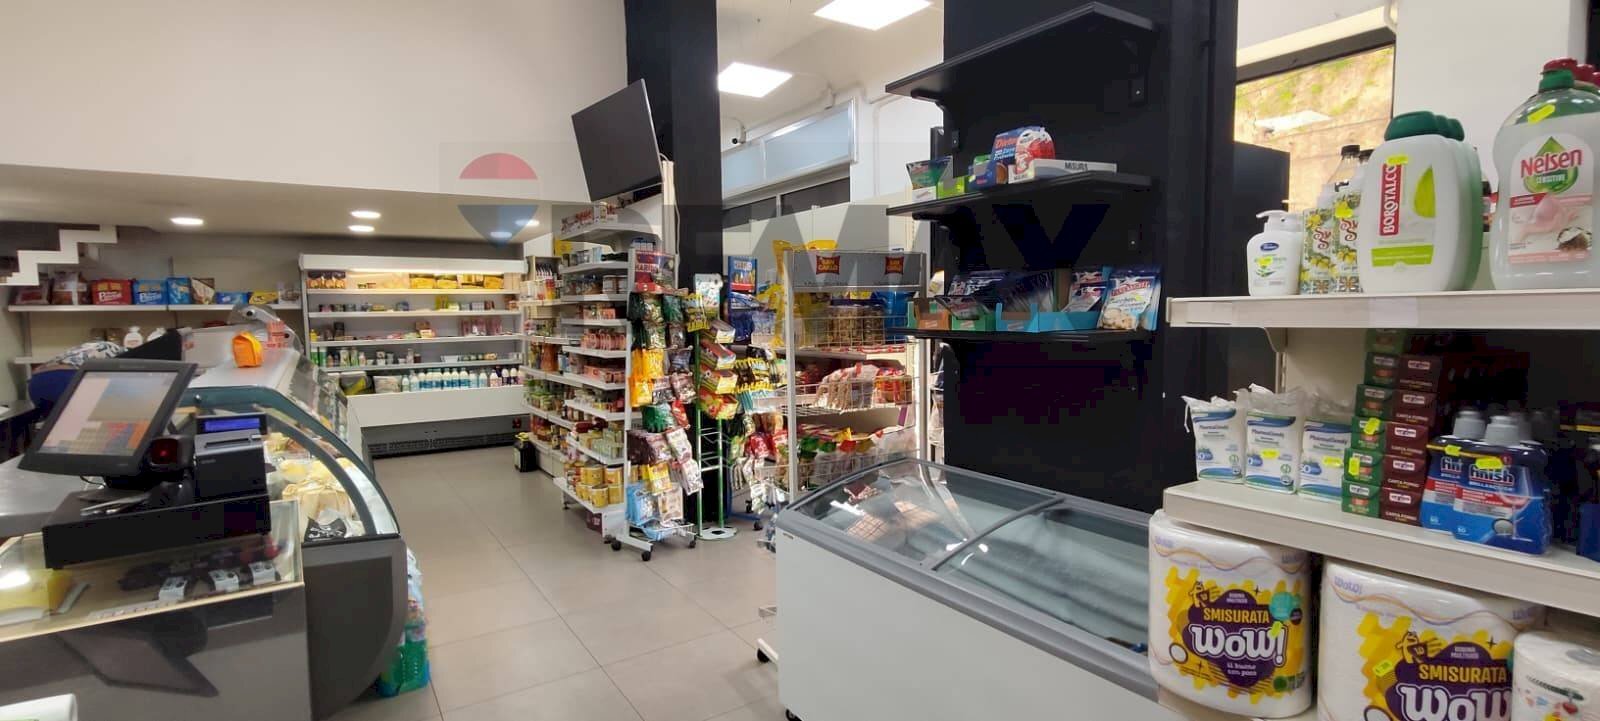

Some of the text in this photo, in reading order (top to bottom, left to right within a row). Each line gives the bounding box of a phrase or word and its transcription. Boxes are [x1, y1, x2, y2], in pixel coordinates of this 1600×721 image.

[1064, 162, 1088, 172] MISURA
[1520, 148, 1583, 179] Nelsen
[1382, 164, 1399, 235] BOROTALCO
[1203, 607, 1270, 624] SMISURATA
[1418, 663, 1507, 684] SMISURATA
